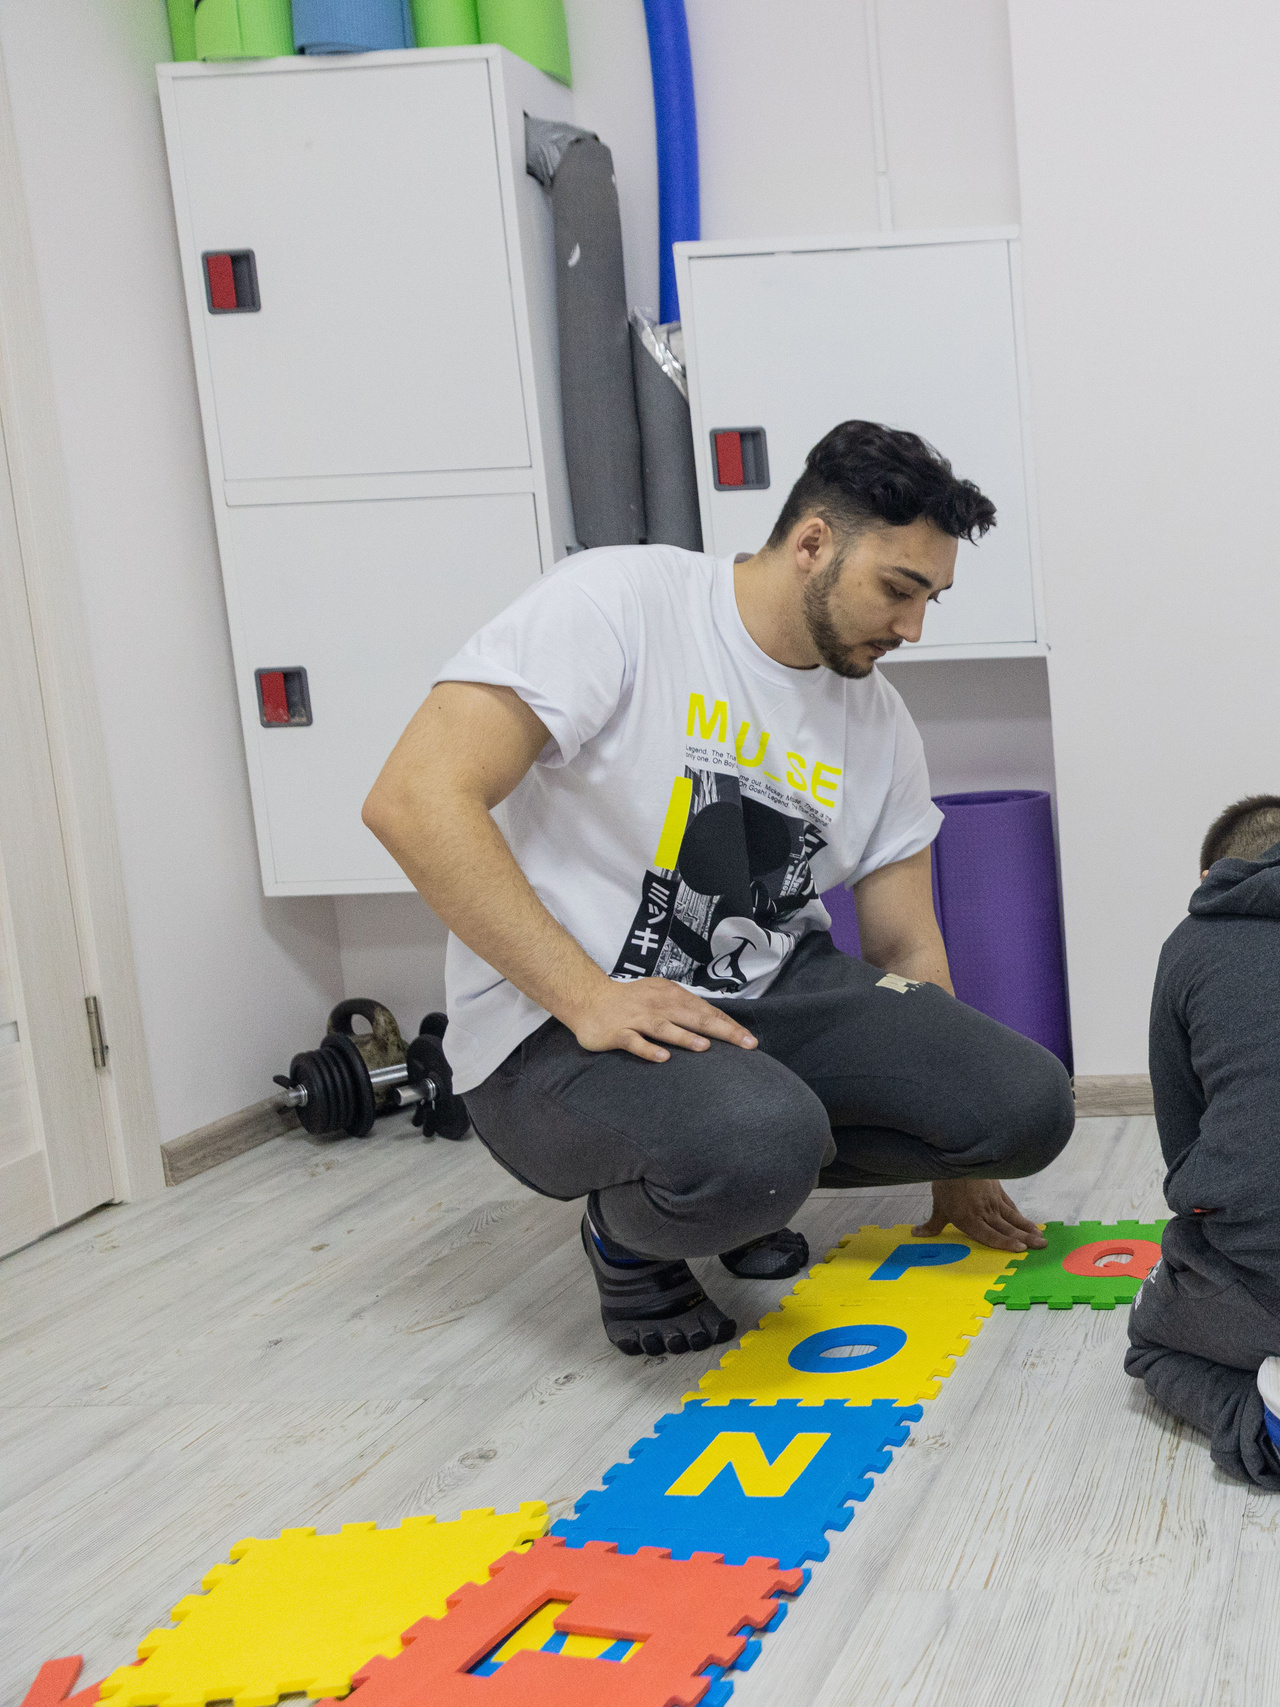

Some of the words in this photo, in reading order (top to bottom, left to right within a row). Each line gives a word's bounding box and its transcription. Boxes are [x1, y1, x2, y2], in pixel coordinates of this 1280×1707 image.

[868, 1243, 971, 1281] P
[787, 1324, 907, 1373] O
[664, 1431, 831, 1496] N
